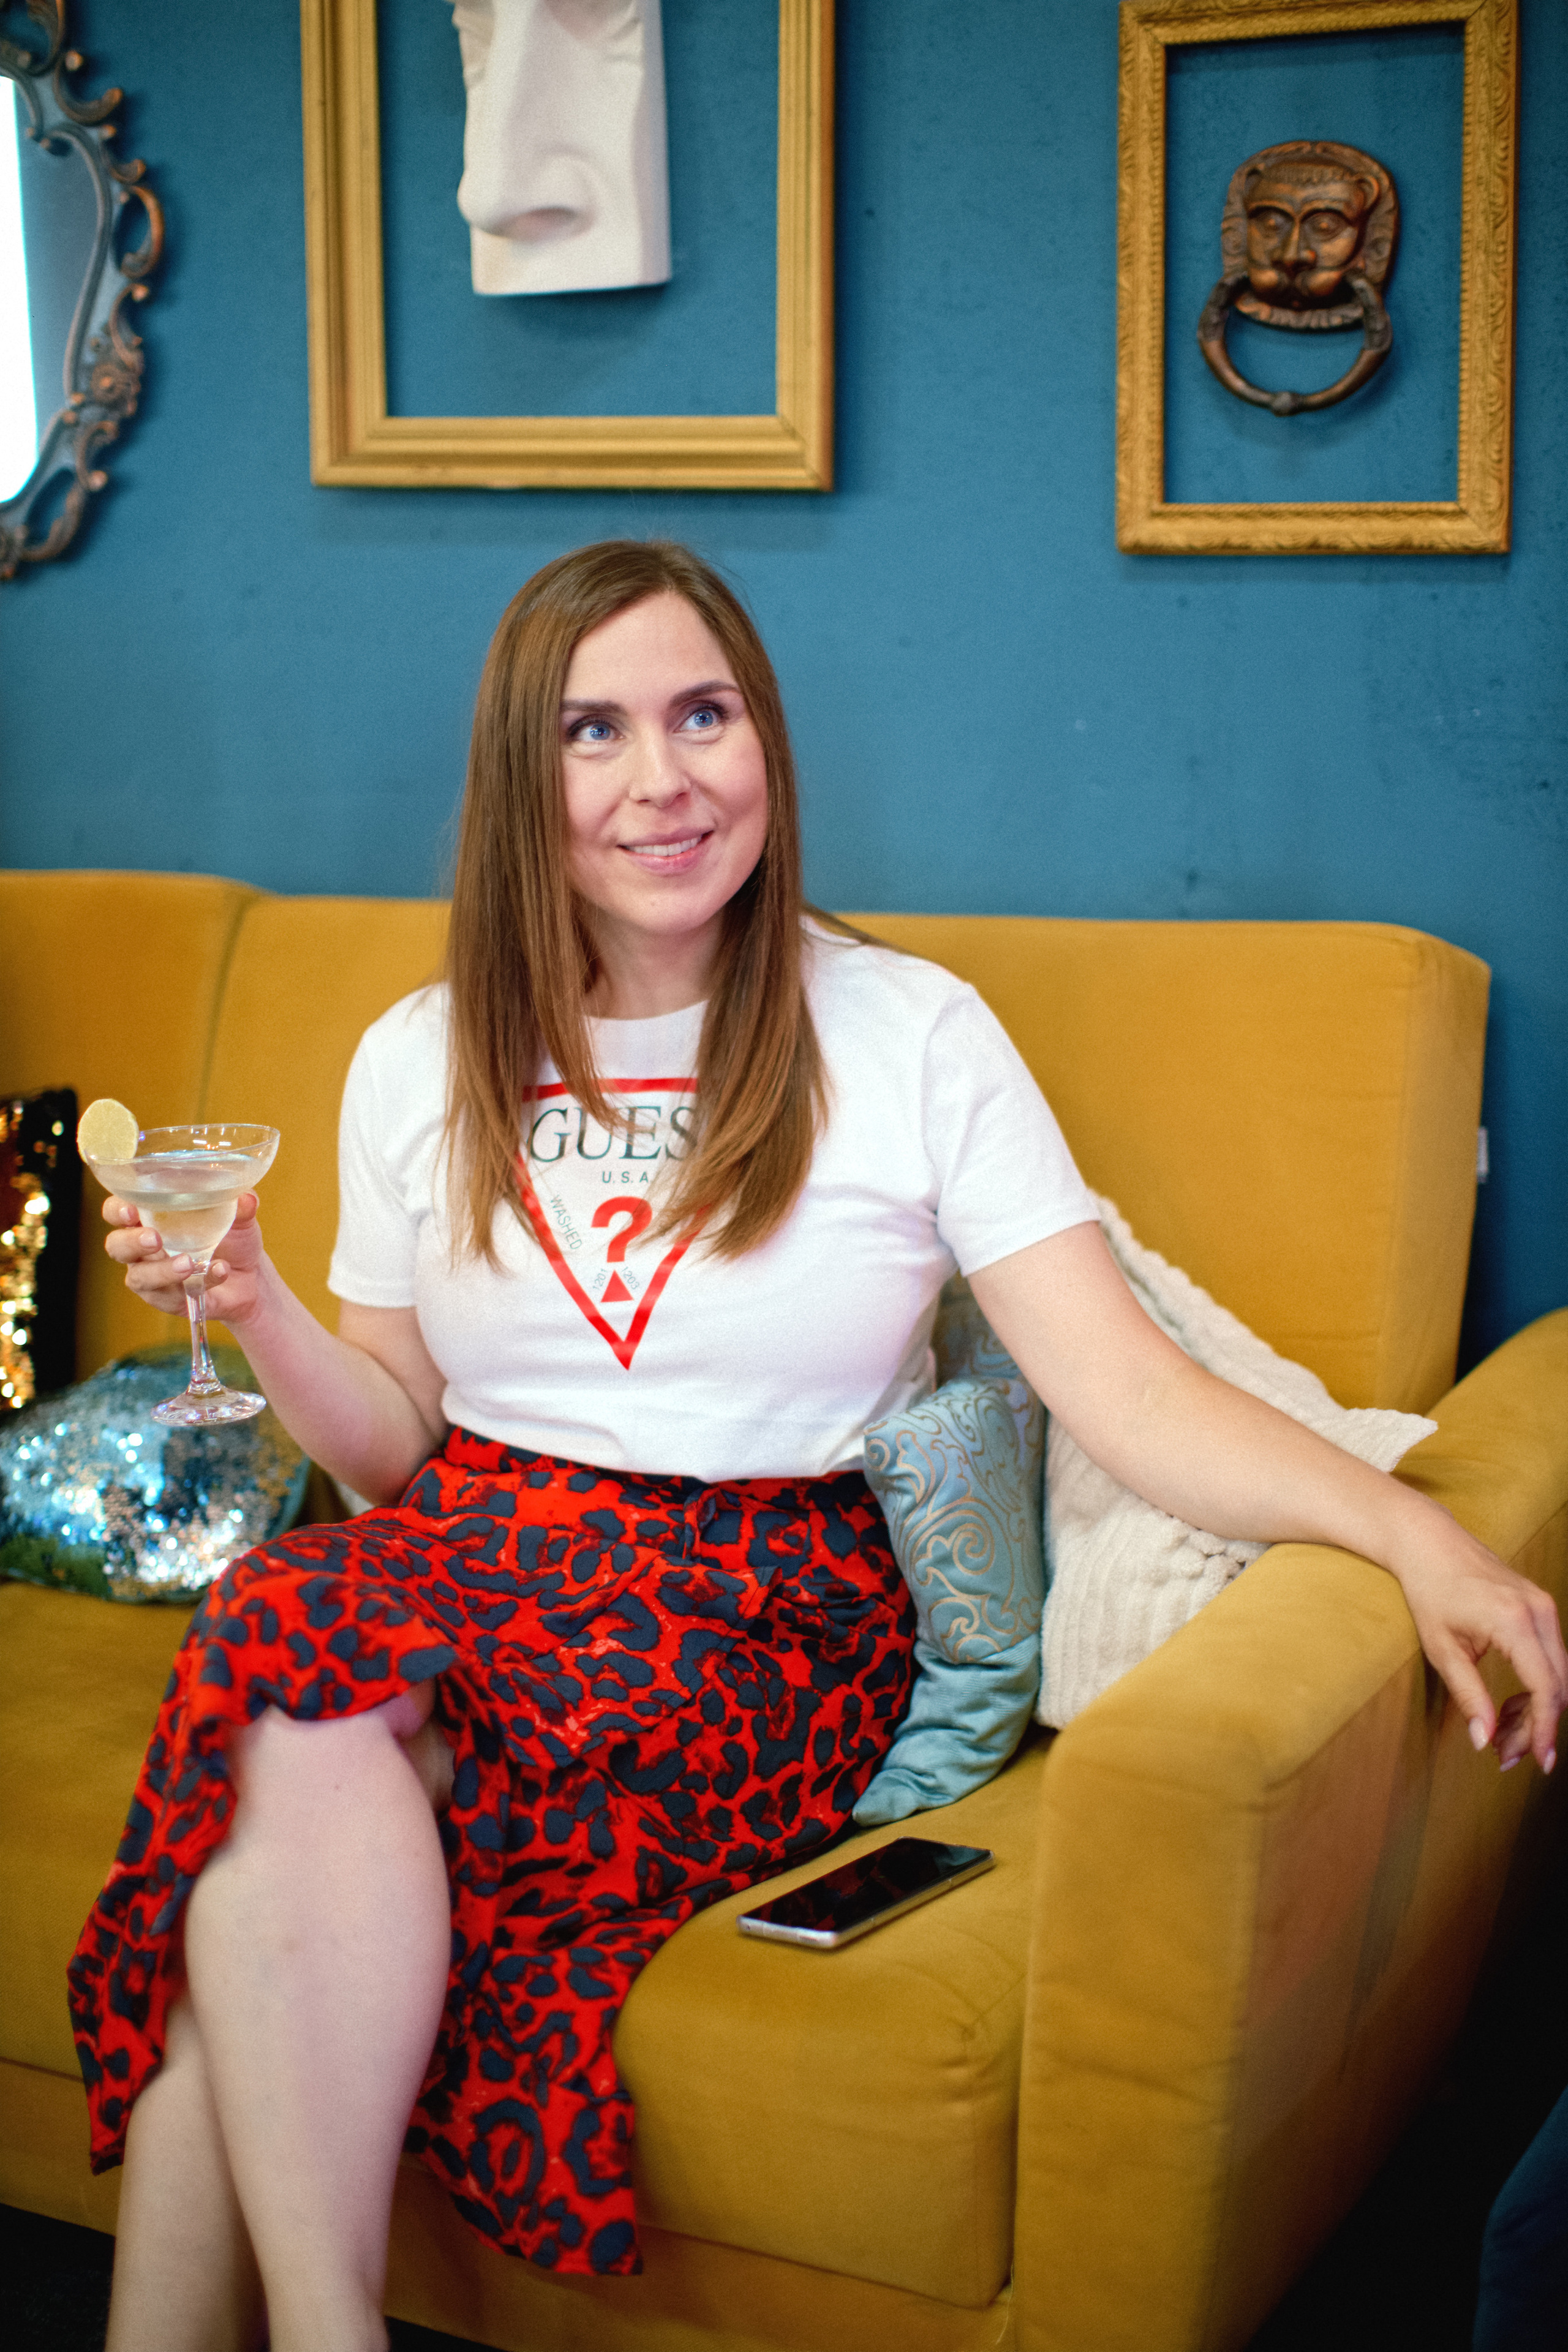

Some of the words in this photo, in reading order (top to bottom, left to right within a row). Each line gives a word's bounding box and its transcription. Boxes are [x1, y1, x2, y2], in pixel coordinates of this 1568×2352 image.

[529, 1106, 698, 1162] GUES
[550, 1194, 582, 1250] WASHED
[592, 1268, 608, 1290] 1201
[621, 1266, 640, 1290] 1203
